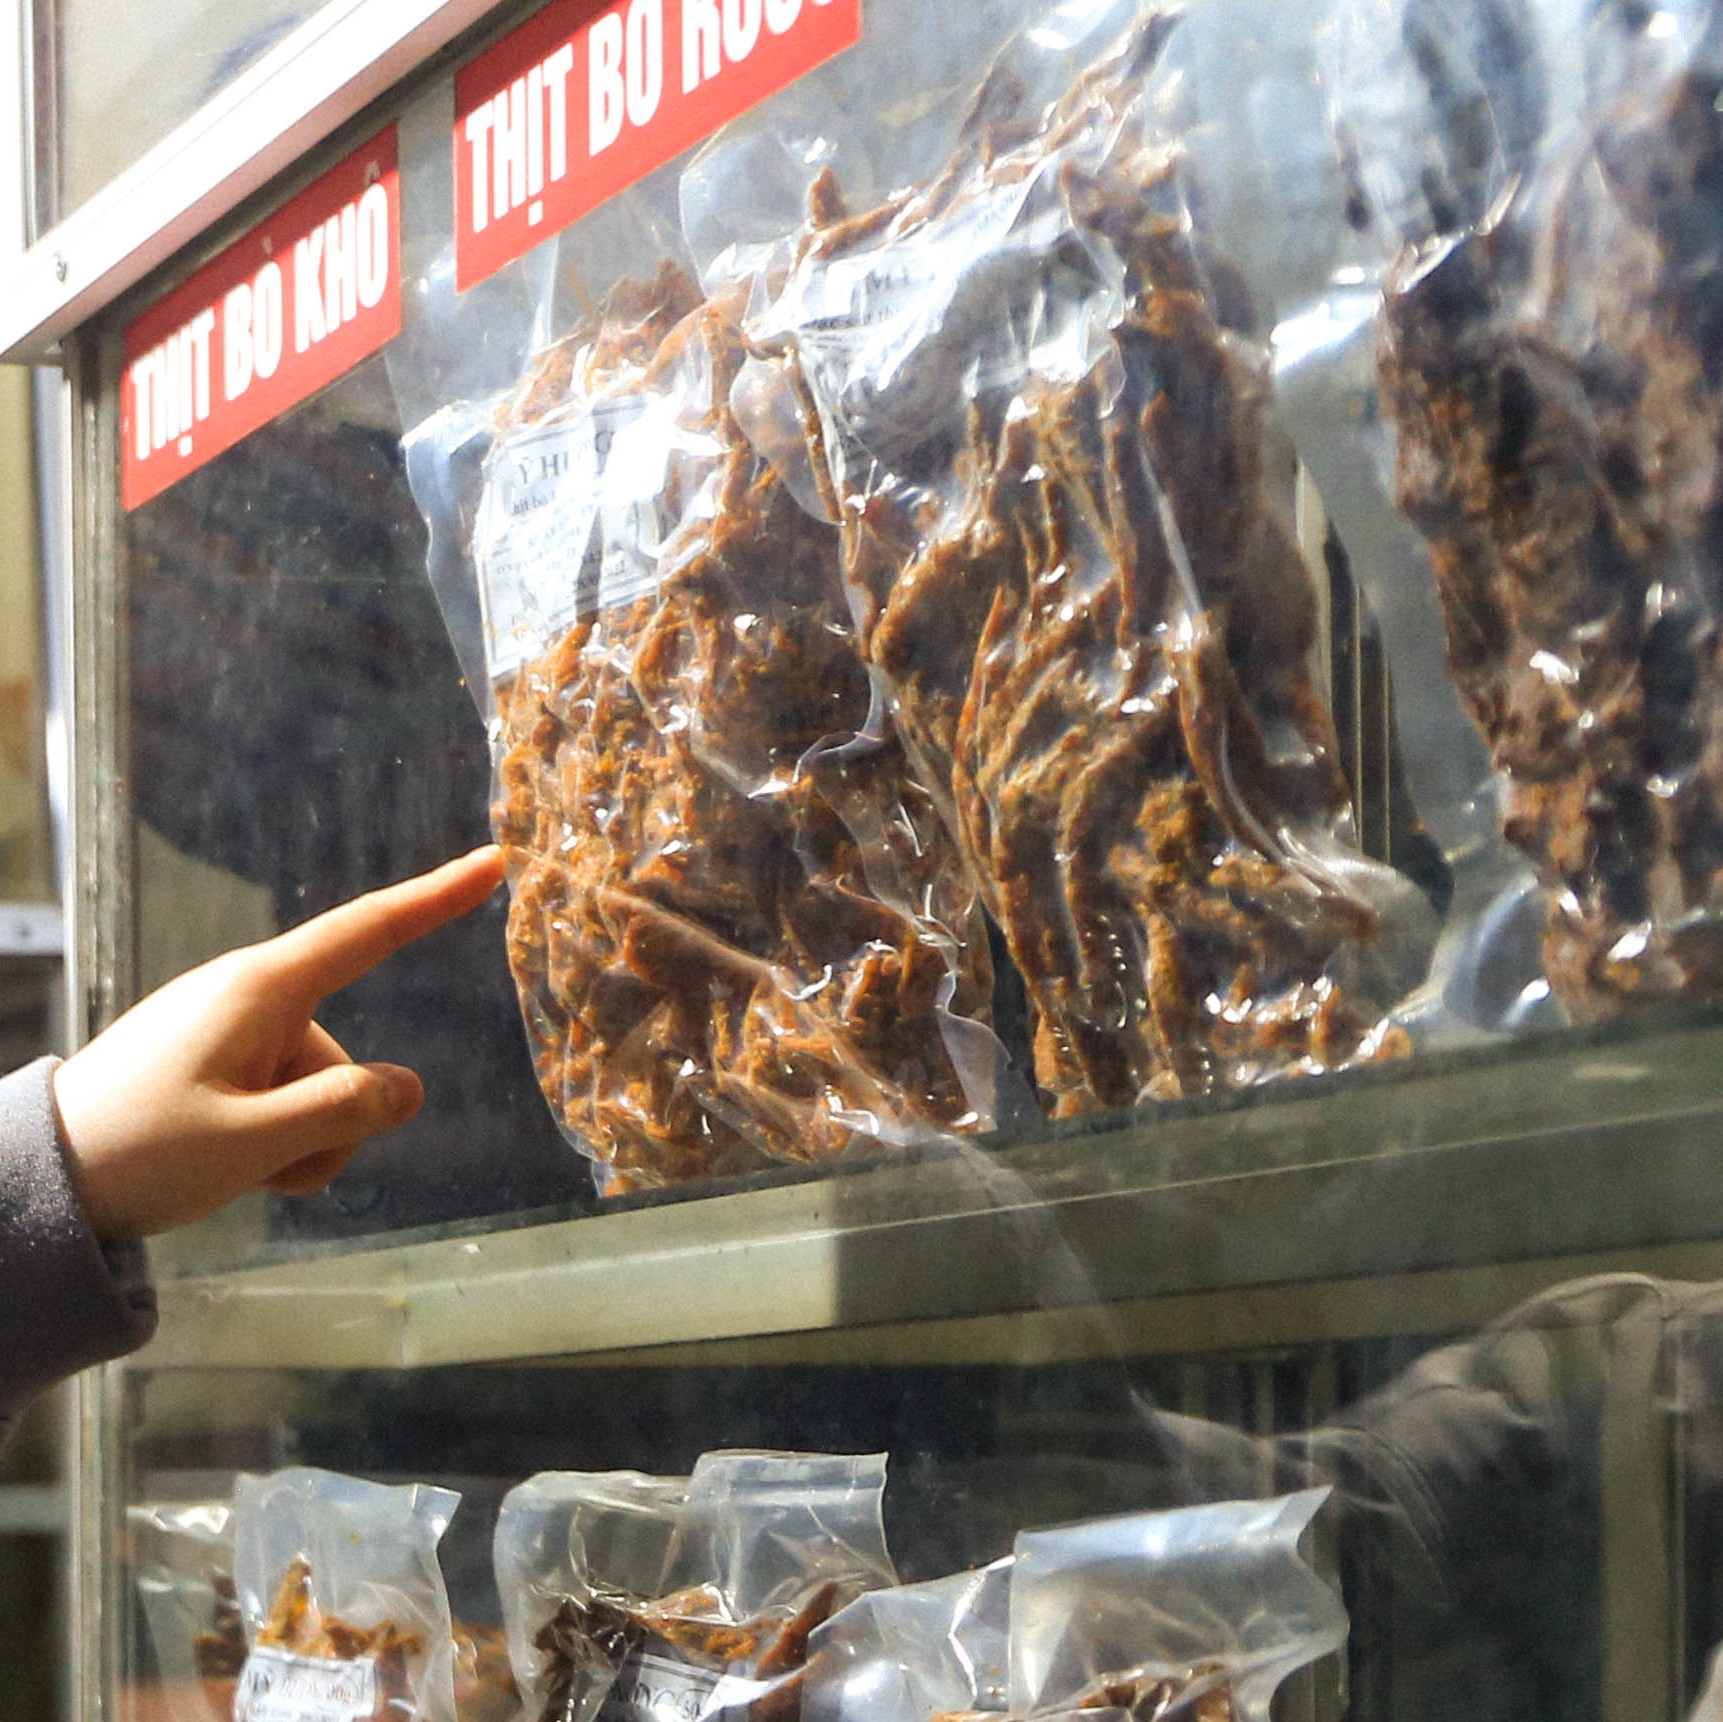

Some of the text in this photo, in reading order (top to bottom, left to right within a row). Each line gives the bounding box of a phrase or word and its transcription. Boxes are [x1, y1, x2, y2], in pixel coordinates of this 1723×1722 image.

[465, 42, 574, 234] THỊT
[129, 160, 390, 462] THỊT BÒ KHÔ
